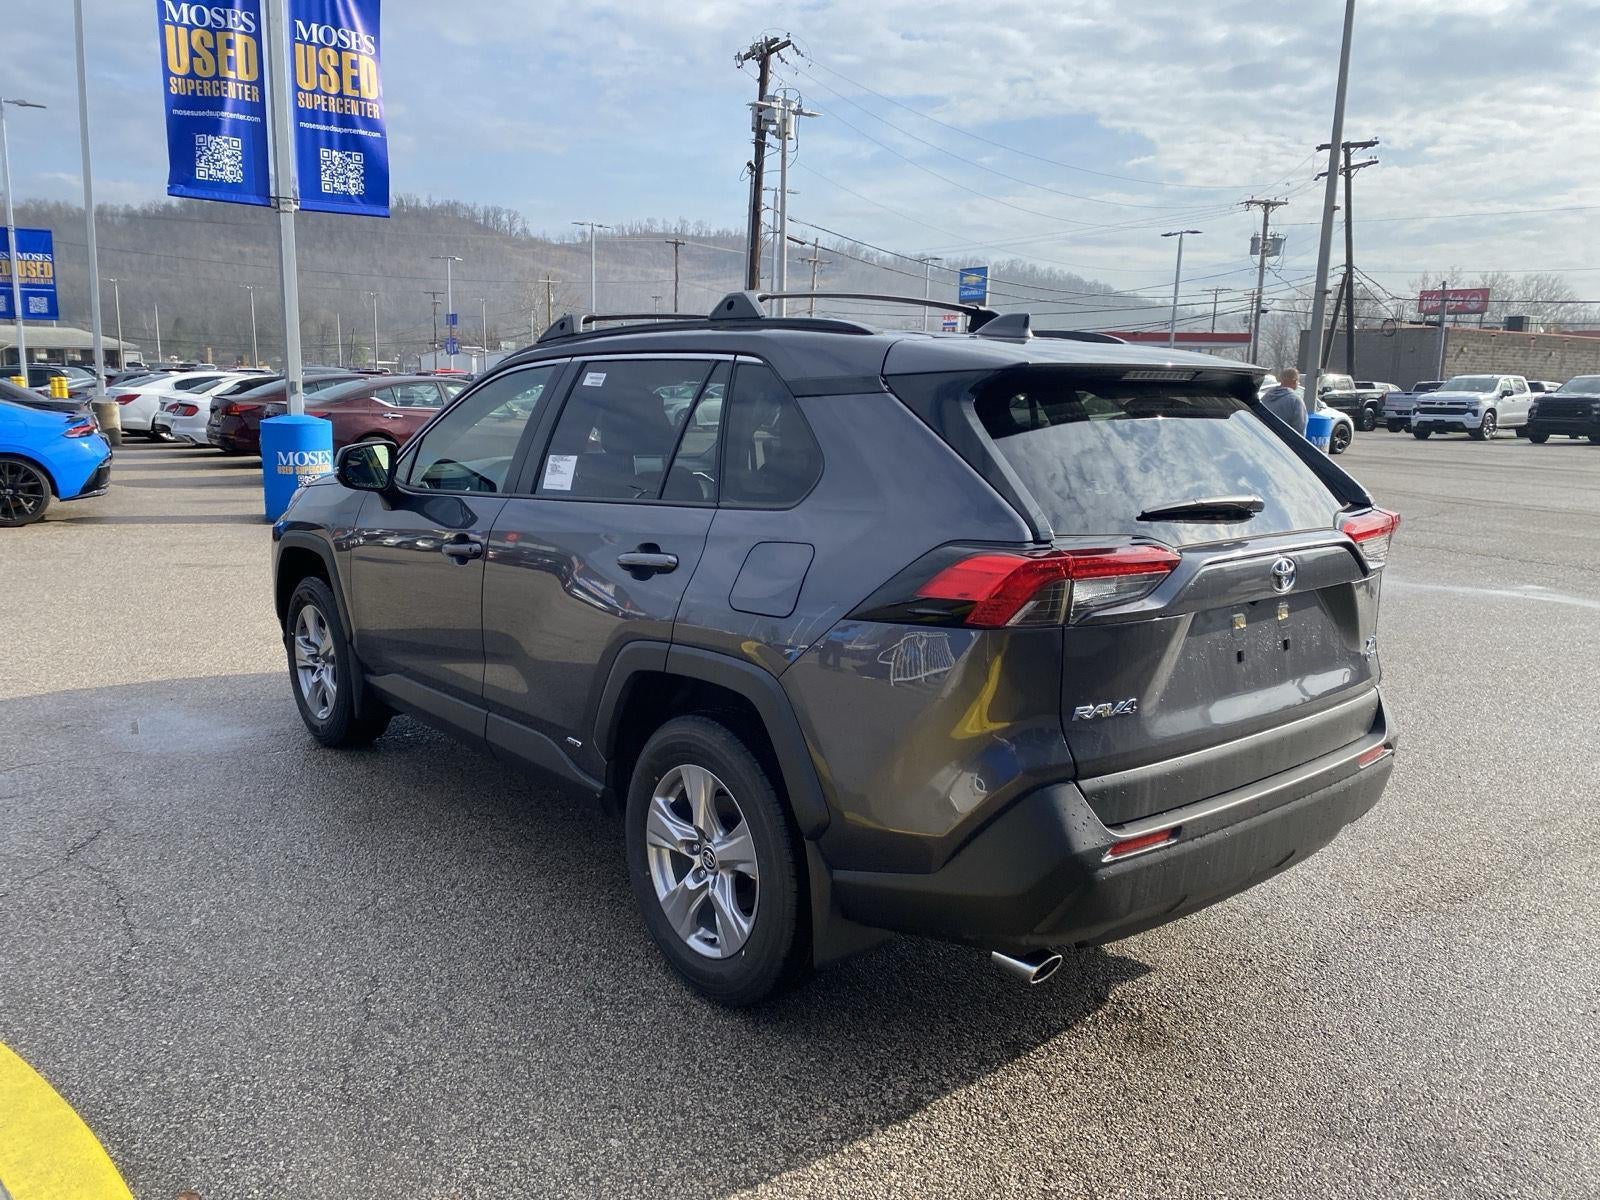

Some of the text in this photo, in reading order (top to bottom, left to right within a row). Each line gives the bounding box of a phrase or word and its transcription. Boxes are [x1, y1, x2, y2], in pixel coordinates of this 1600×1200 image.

[164, 0, 256, 33] MOSES
[294, 19, 376, 55] MOSES
[165, 25, 258, 81] USED
[295, 43, 378, 99] USED
[170, 76, 259, 102] SUPERCENTER
[172, 108, 261, 123] mosesusedsupercenter.com
[298, 92, 380, 119] SUPERCENTER
[299, 121, 381, 138] mosesusedsupercenter.com
[16, 252, 52, 261] MOSES
[17, 260, 53, 278] USED
[277, 450, 331, 466] MOSES
[1071, 698, 1137, 721] RAV4
